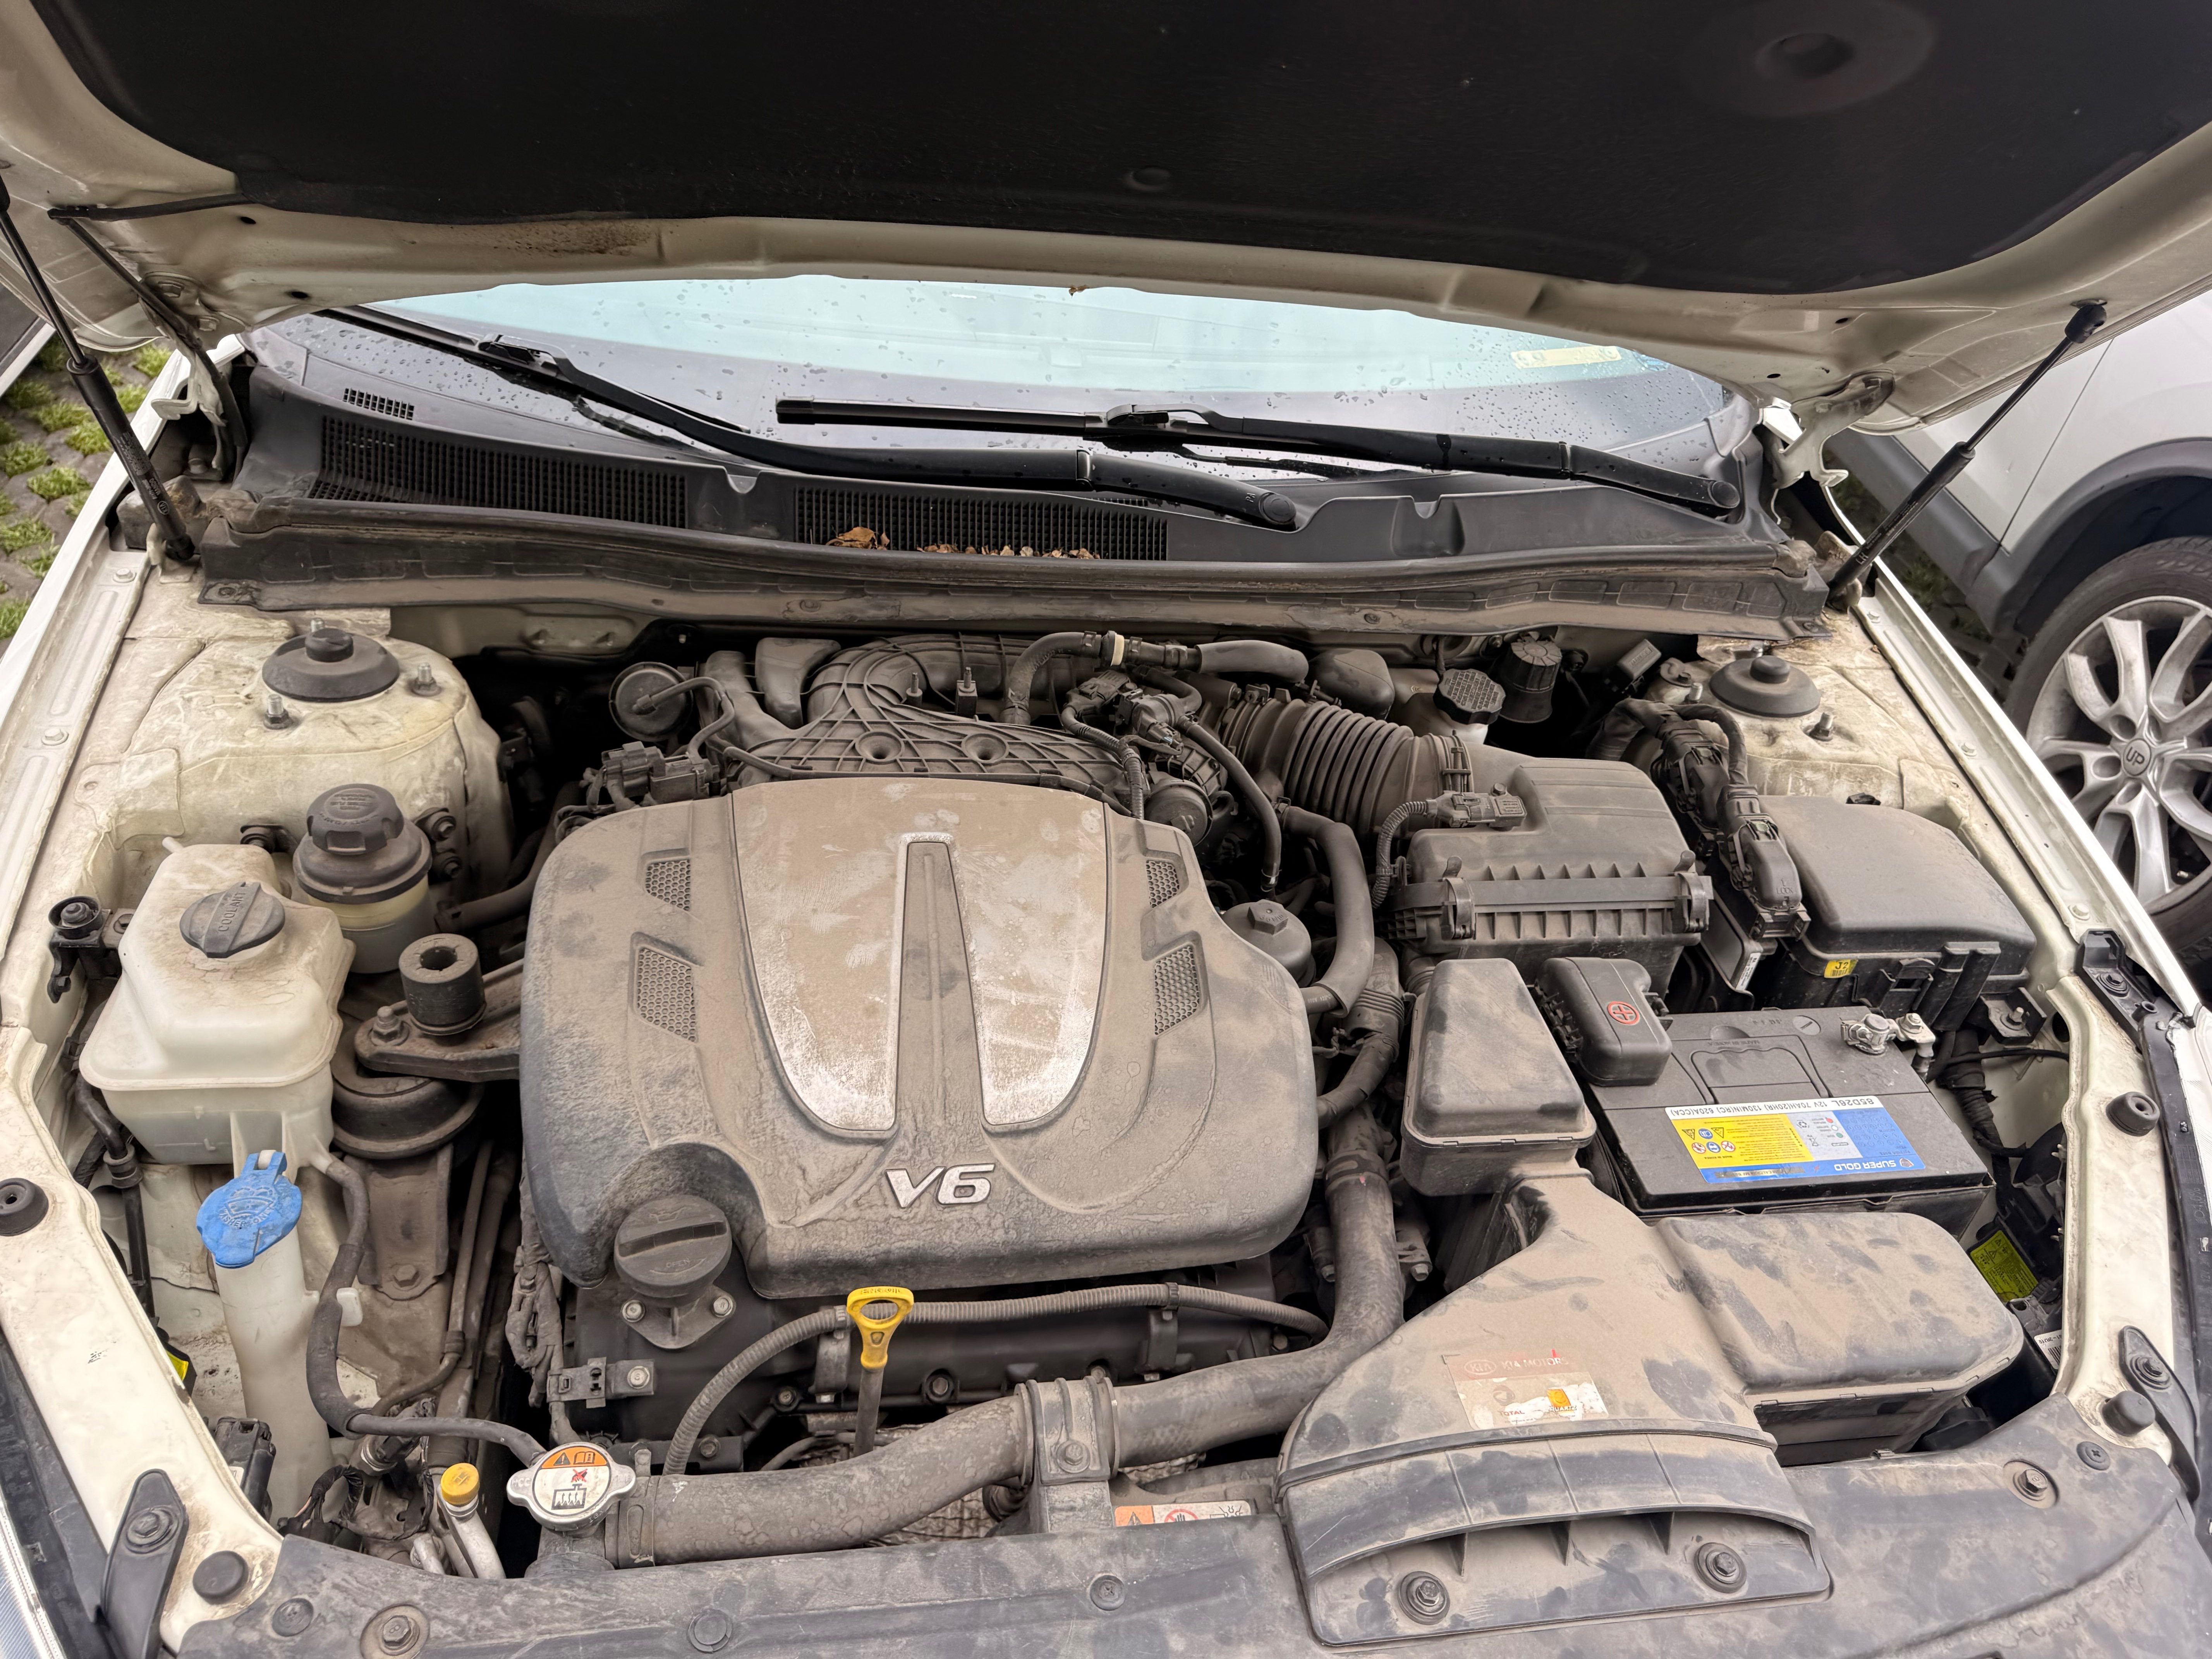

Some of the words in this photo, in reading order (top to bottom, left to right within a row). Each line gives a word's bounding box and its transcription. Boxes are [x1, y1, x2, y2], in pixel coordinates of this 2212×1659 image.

[218, 892, 246, 932] COOLANT
[1834, 1163, 1862, 1171] GOLD
[1862, 1160, 1897, 1170] SUPER
[884, 1163, 996, 1209] V6
[666, 1257, 690, 1268] OPEN
[1471, 1364, 1491, 1372] KIA
[1501, 1360, 1521, 1370] KIA
[1523, 1357, 1570, 1368] MOTORS
